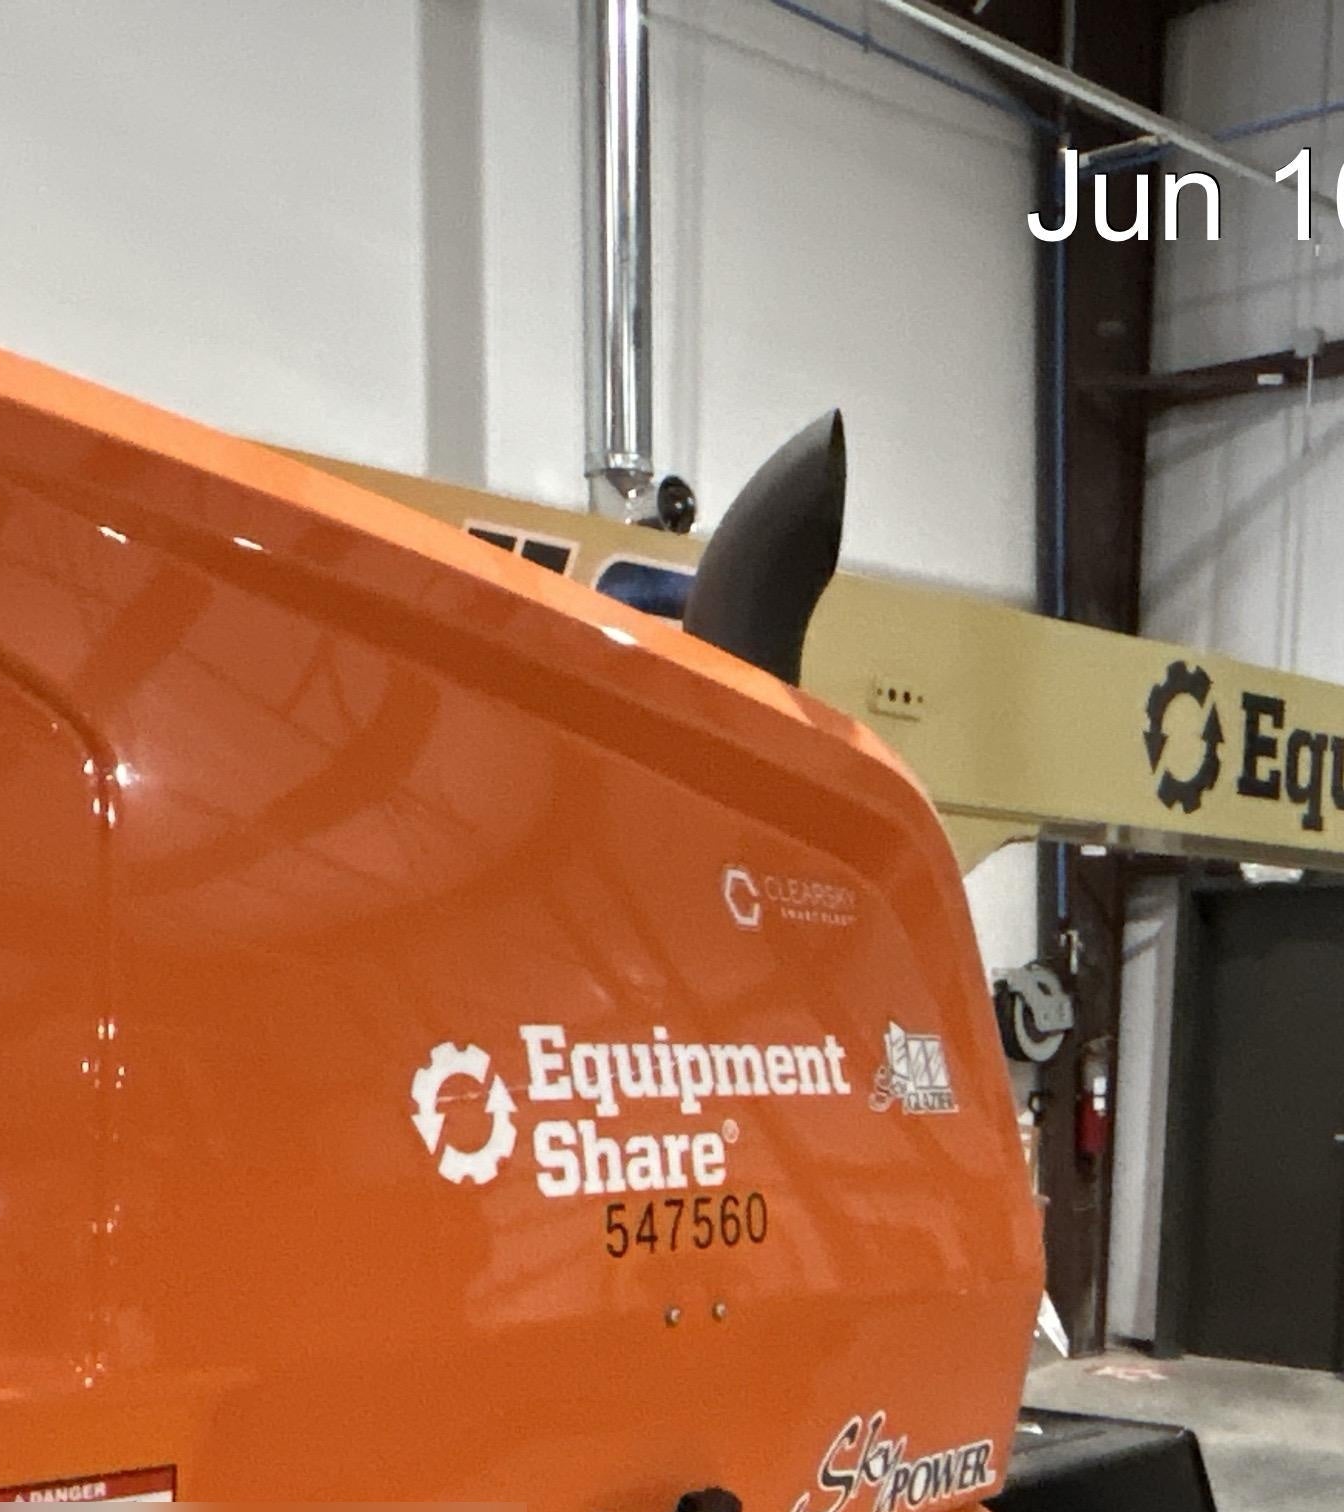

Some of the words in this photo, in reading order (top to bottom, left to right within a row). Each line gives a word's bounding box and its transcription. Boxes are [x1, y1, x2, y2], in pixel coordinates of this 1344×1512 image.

[519, 1025, 852, 1117] Equipment
[605, 1193, 768, 1258] 547560
[30, 1481, 106, 1502] DANGER
